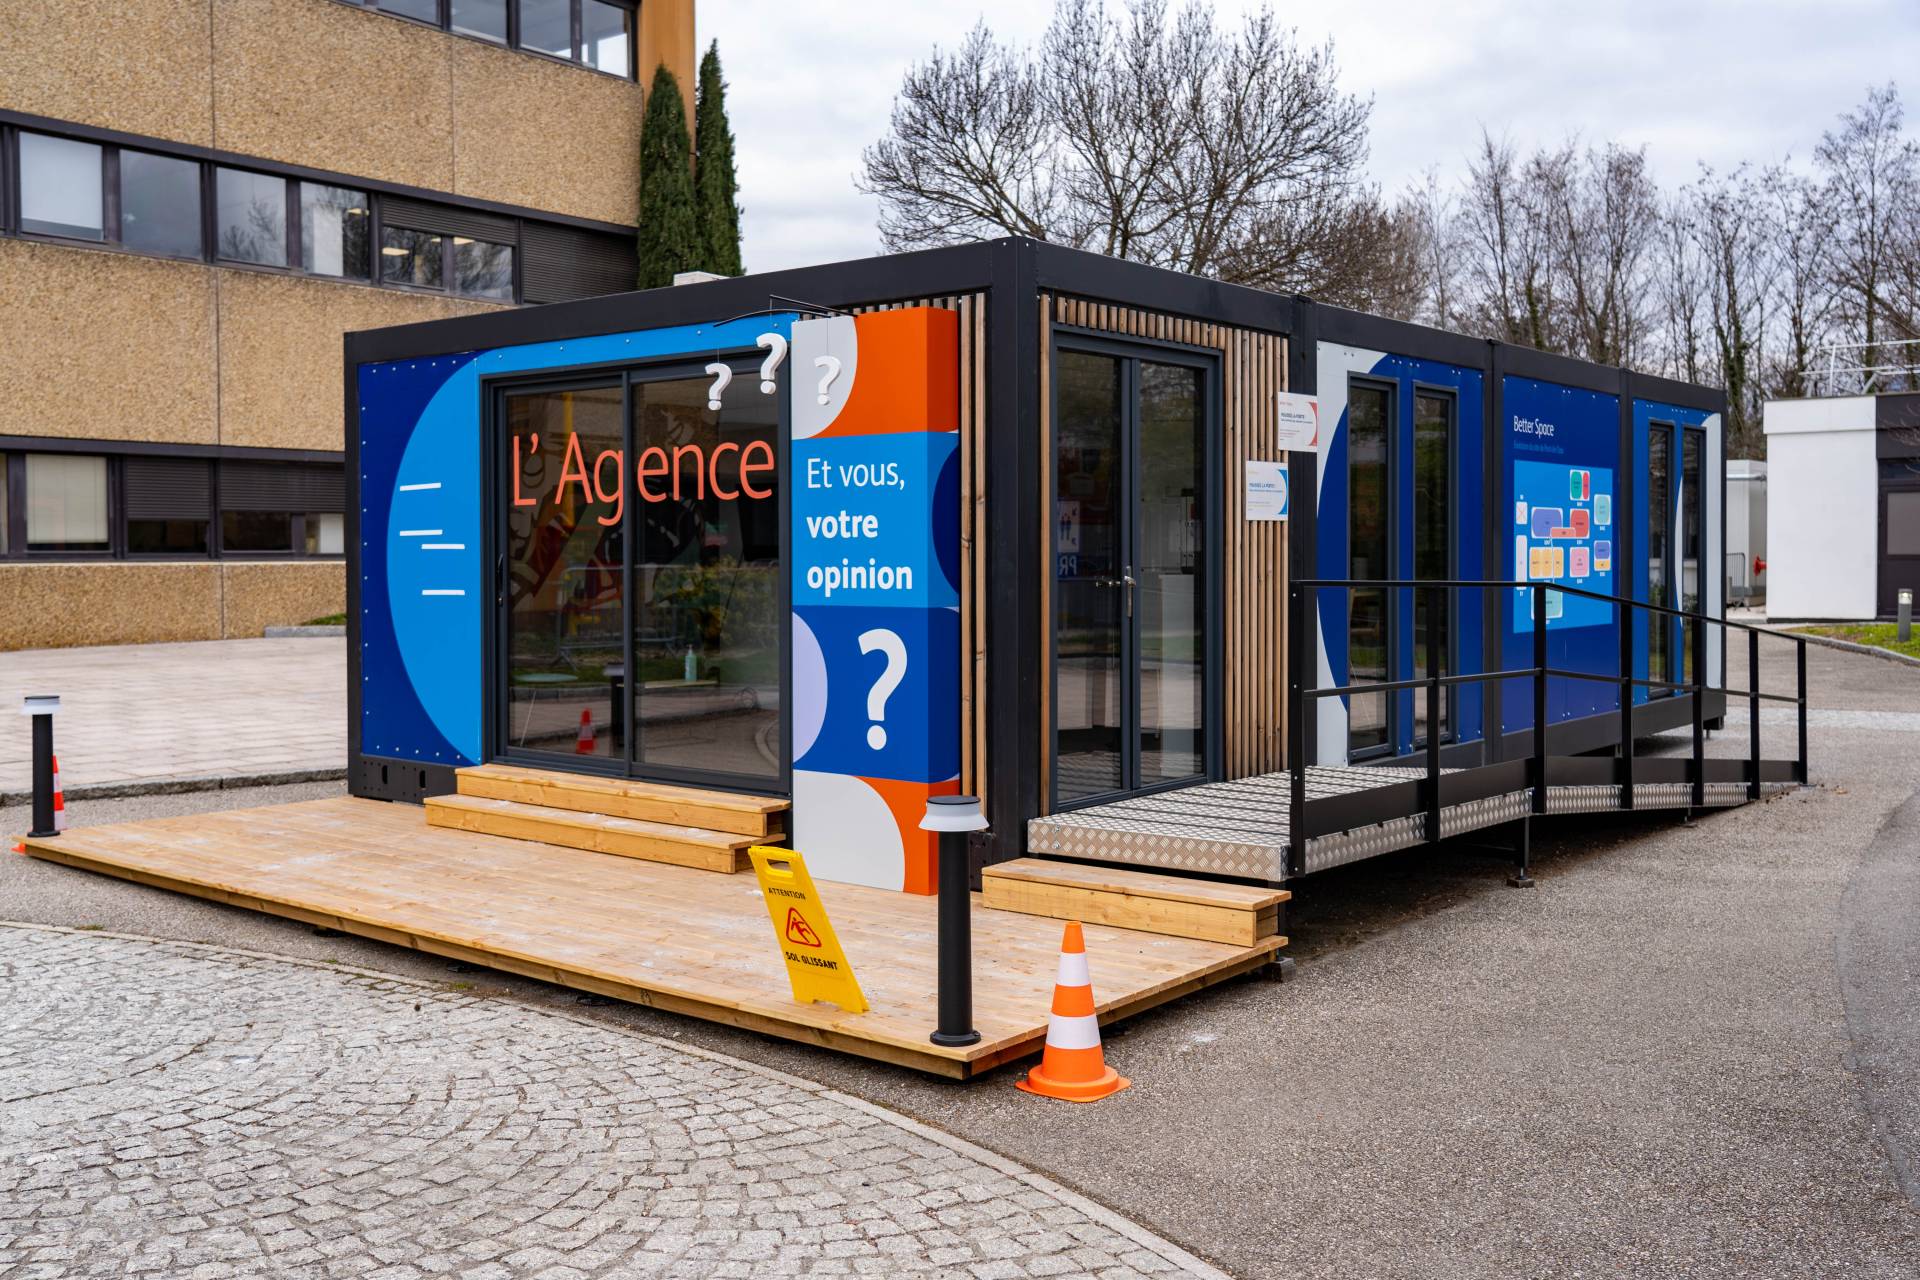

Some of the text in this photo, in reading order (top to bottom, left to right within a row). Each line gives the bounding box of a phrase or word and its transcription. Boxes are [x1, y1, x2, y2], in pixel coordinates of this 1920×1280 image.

[1513, 415, 1554, 439] Better Space
[807, 458, 905, 491] Et vous,
[806, 510, 878, 538] votre
[807, 558, 913, 597] opinion
[858, 628, 908, 751] ?
[768, 887, 806, 899] ATTENTION
[785, 951, 838, 970] SOL GLISSANT
